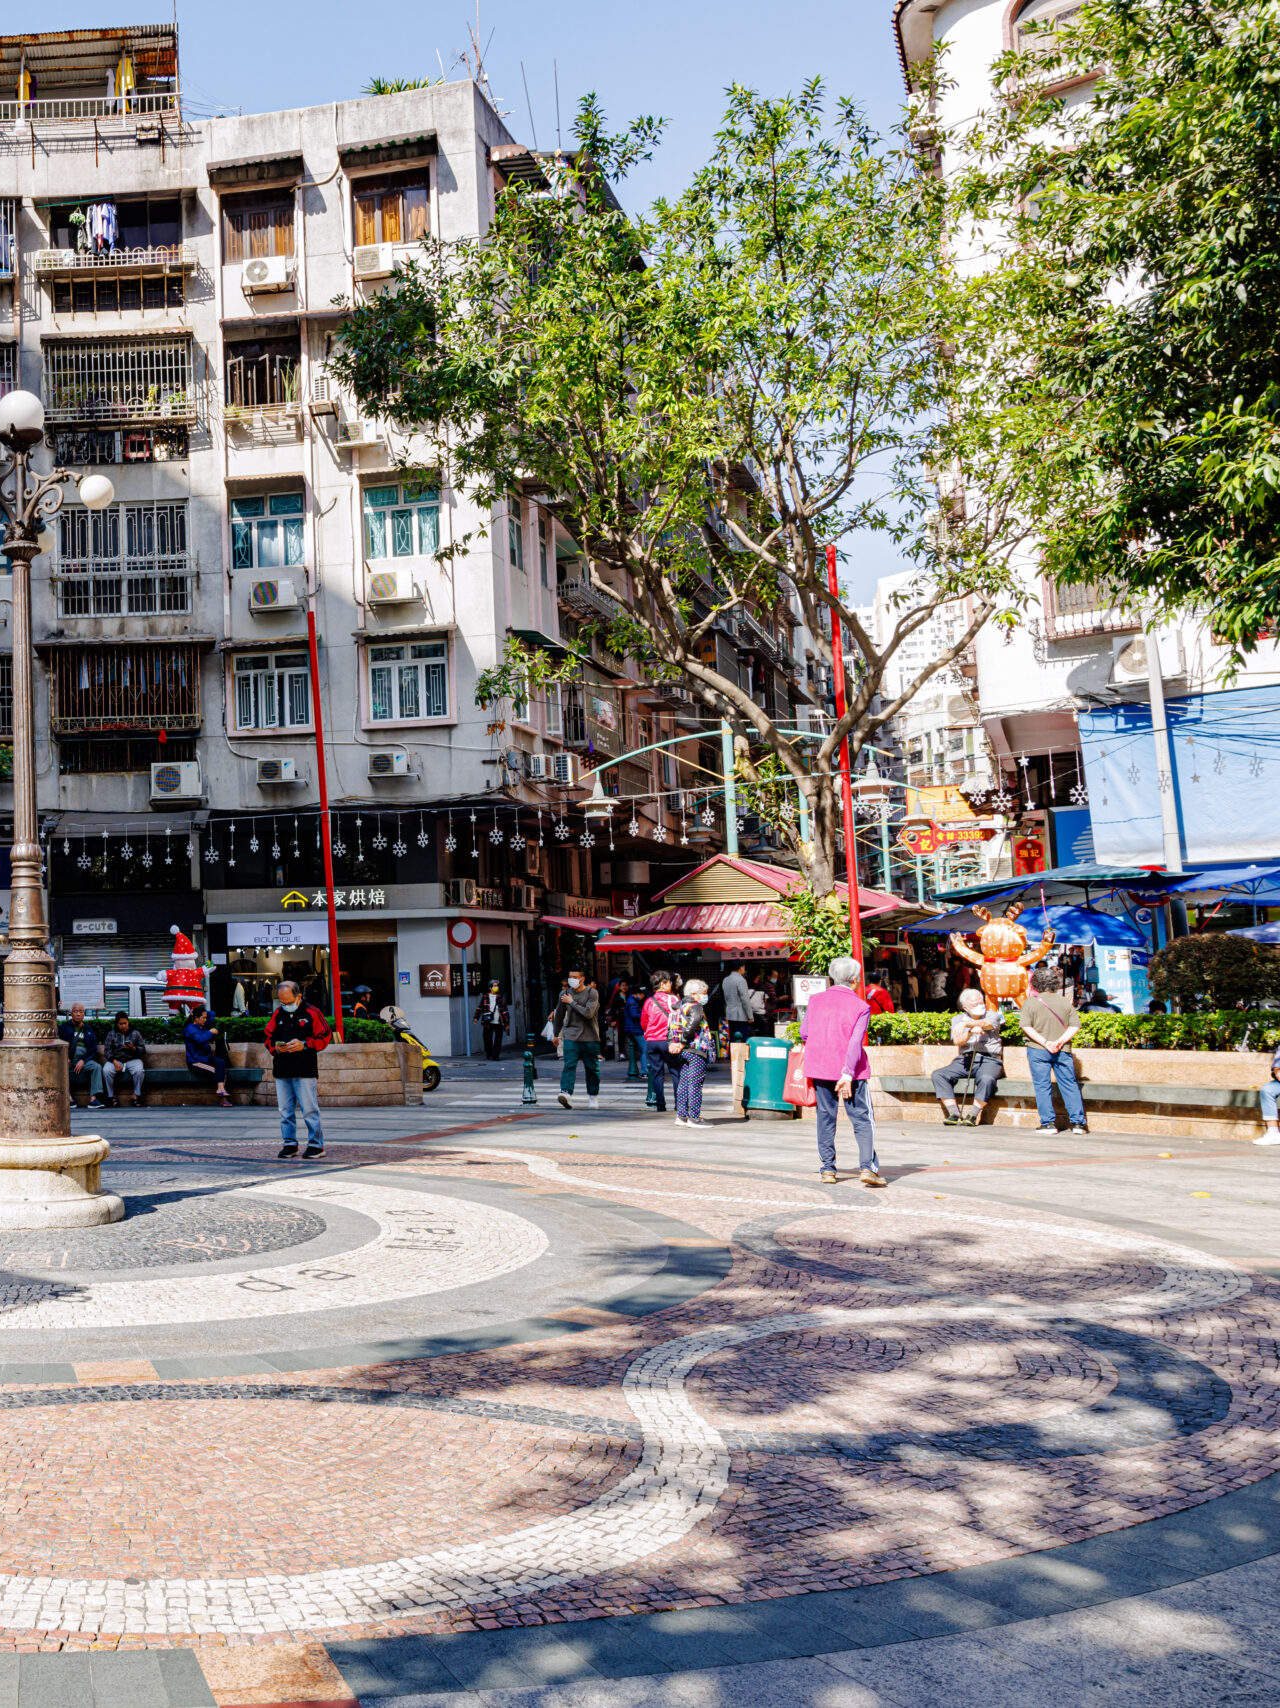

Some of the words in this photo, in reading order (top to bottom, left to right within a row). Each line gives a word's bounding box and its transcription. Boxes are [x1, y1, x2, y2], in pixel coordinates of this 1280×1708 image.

[311, 888, 385, 906] 本家烘焙
[76, 920, 113, 931] e-cute
